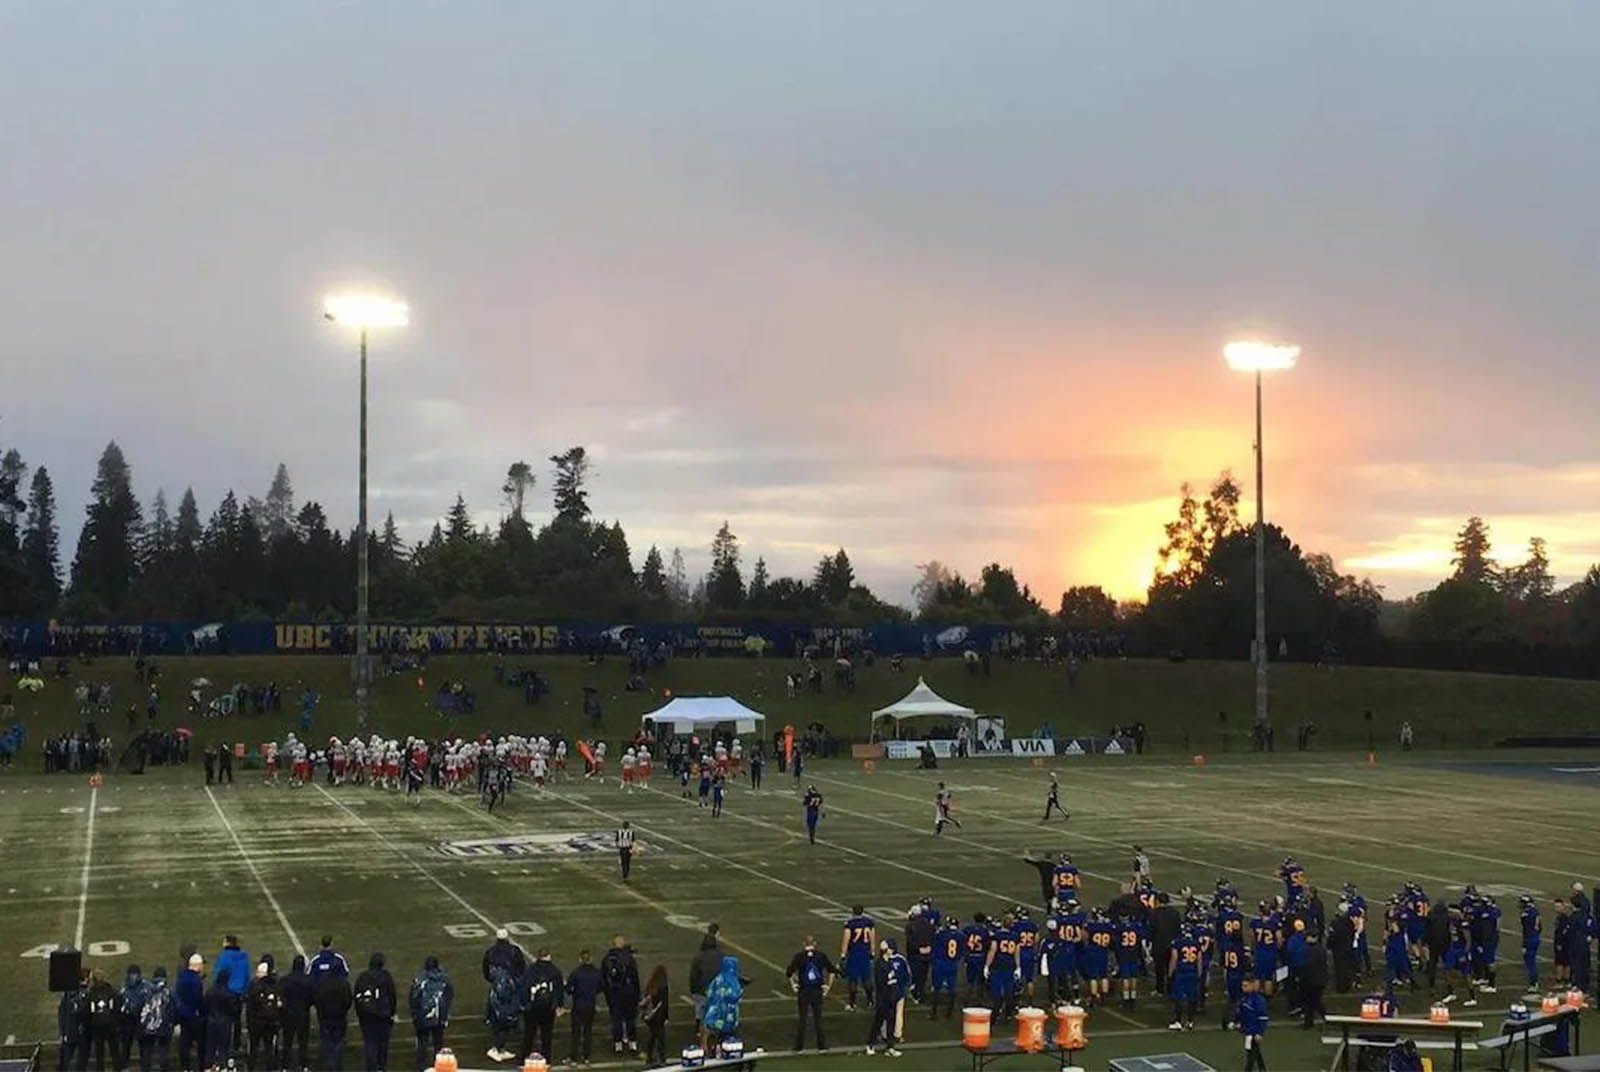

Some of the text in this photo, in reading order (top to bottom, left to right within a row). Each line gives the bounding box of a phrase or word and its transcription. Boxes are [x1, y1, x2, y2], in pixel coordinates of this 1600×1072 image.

[275, 624, 558, 649] UBC THERBRDS
[1019, 740, 1046, 752] VIA
[947, 939, 957, 958] 8
